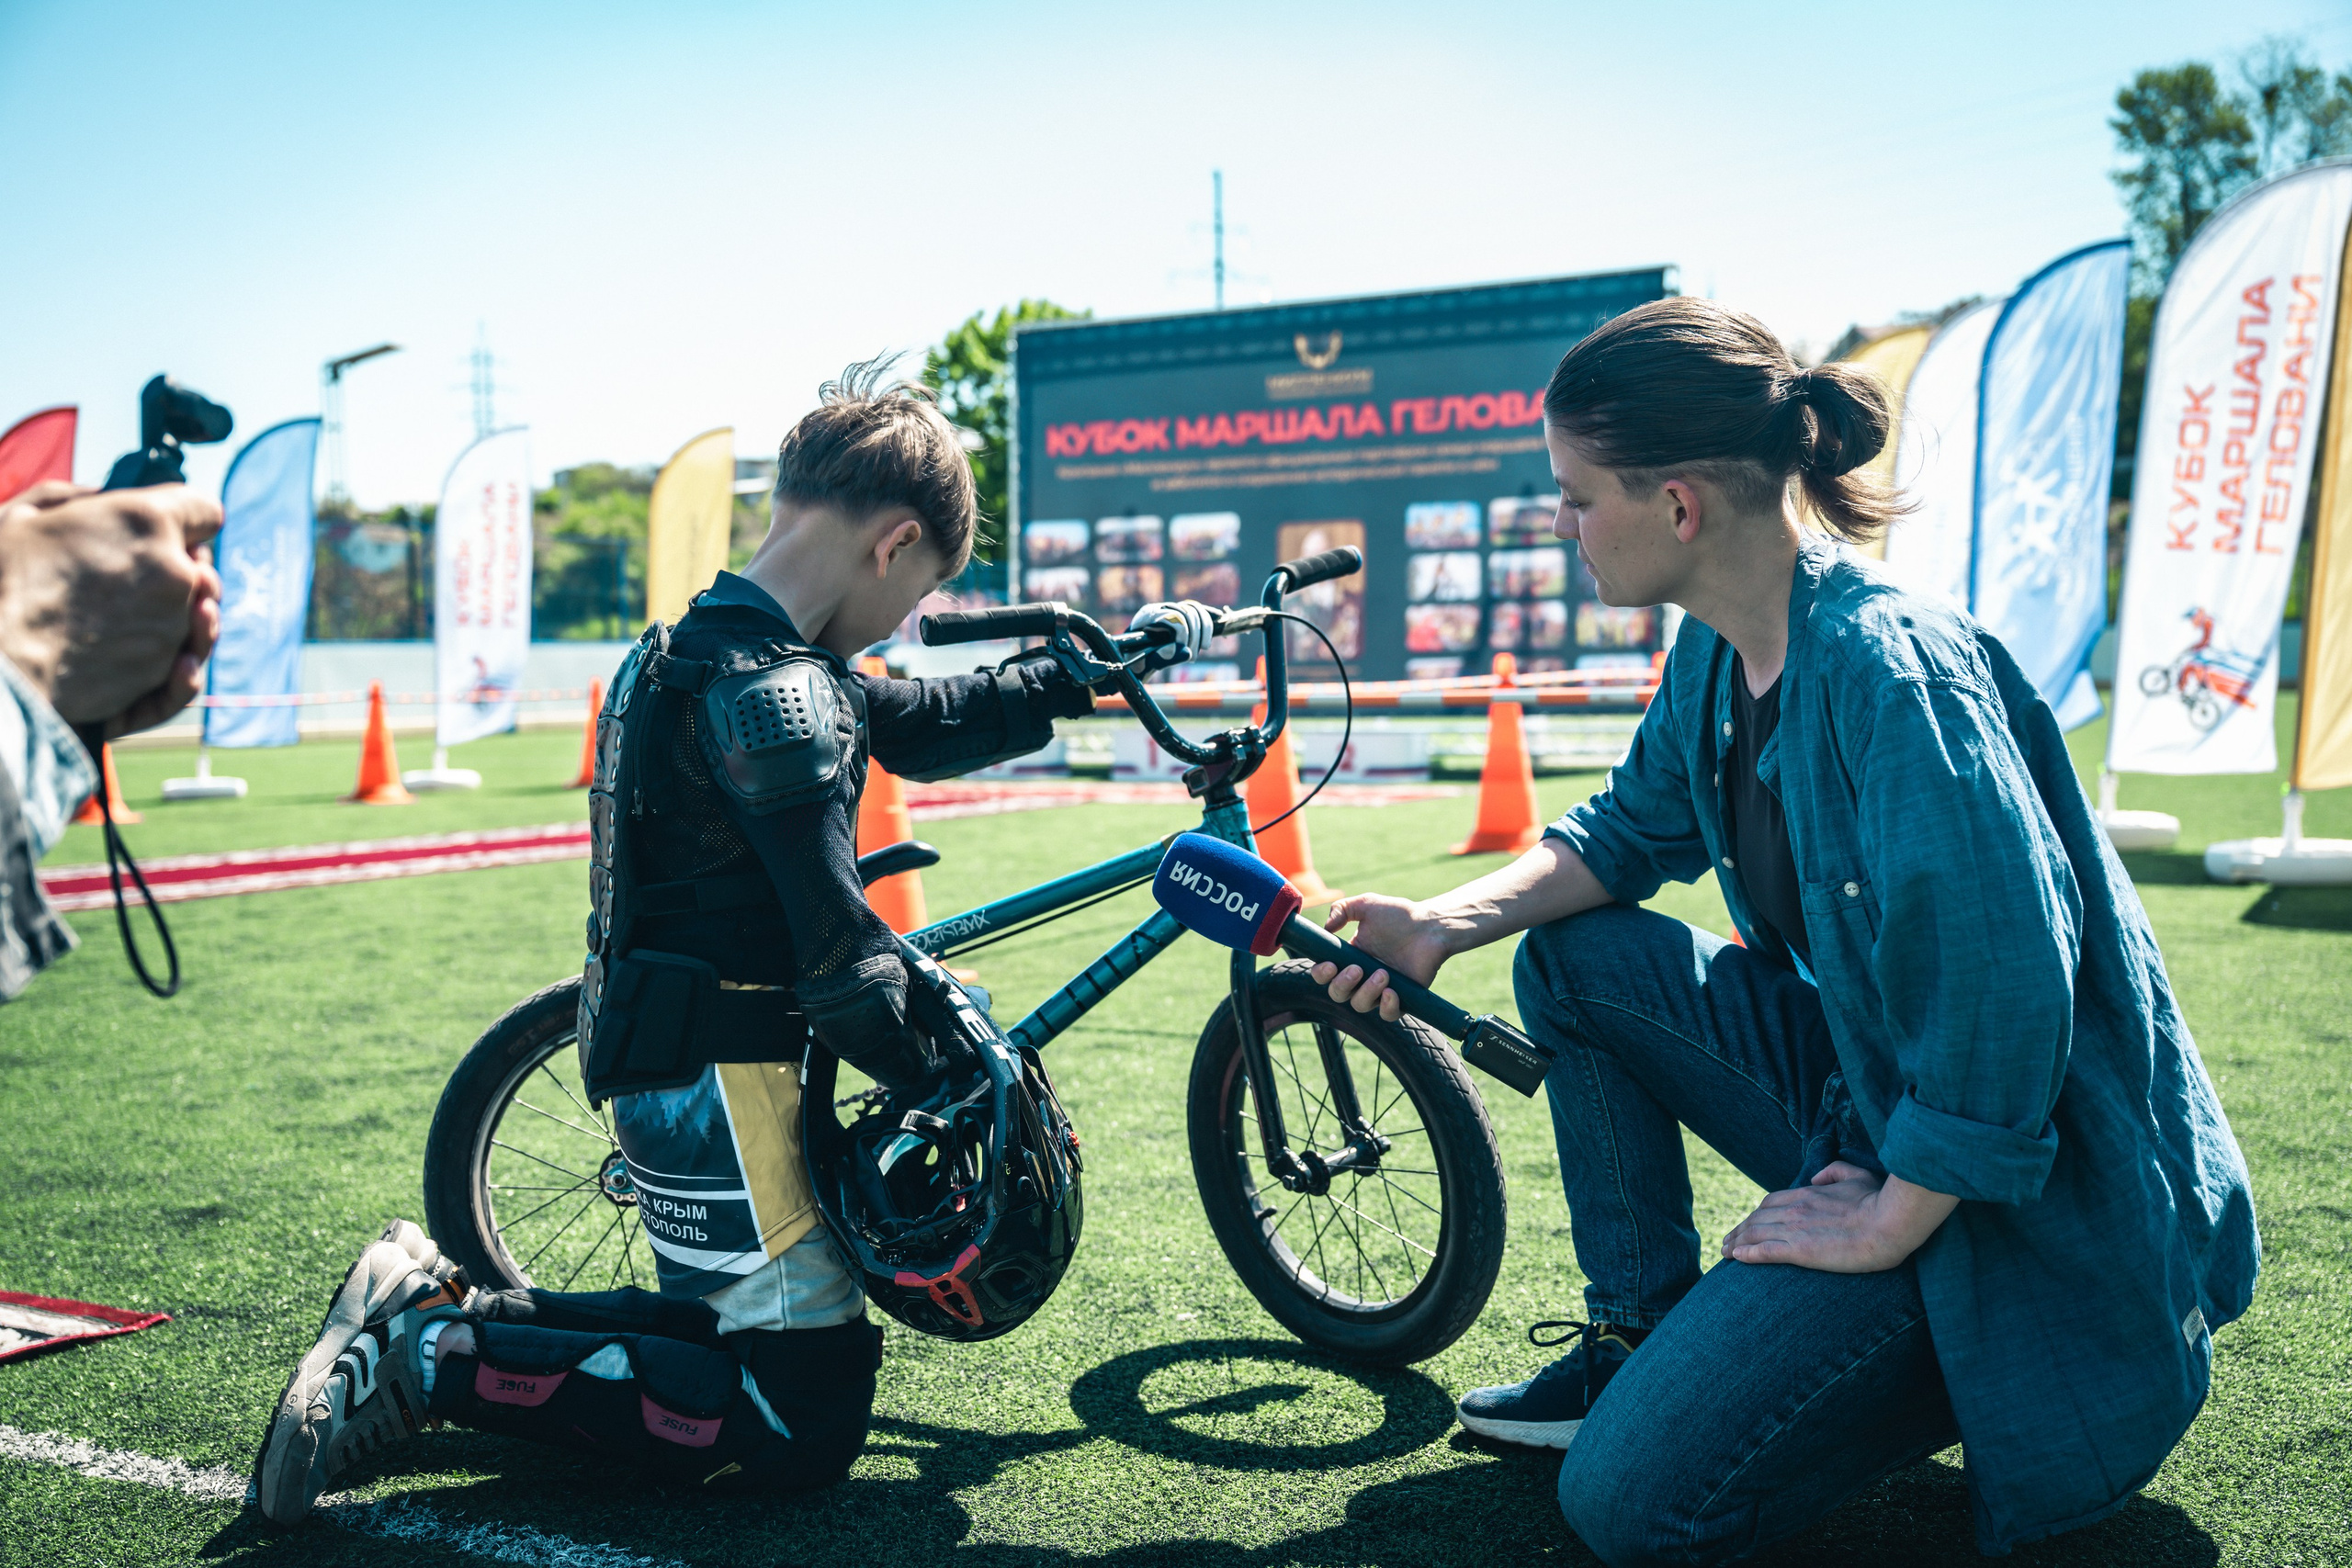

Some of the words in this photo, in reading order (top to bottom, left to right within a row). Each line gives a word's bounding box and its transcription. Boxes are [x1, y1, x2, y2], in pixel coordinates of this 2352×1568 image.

[1046, 416, 1170, 457] КУБОК
[1174, 400, 1385, 449] МАРШАЛА
[2211, 276, 2275, 554] МАРШАЛА
[2254, 274, 2323, 555] ГЕЛОВАНИ
[2165, 382, 2216, 551] КУБОК
[1169, 860, 1260, 922] РОССИЯ
[1498, 1040, 1538, 1065] SENNHEISER
[653, 1198, 707, 1221] КРЫМ
[496, 1379, 537, 1393] FUSE
[659, 1415, 698, 1436] FUSE
